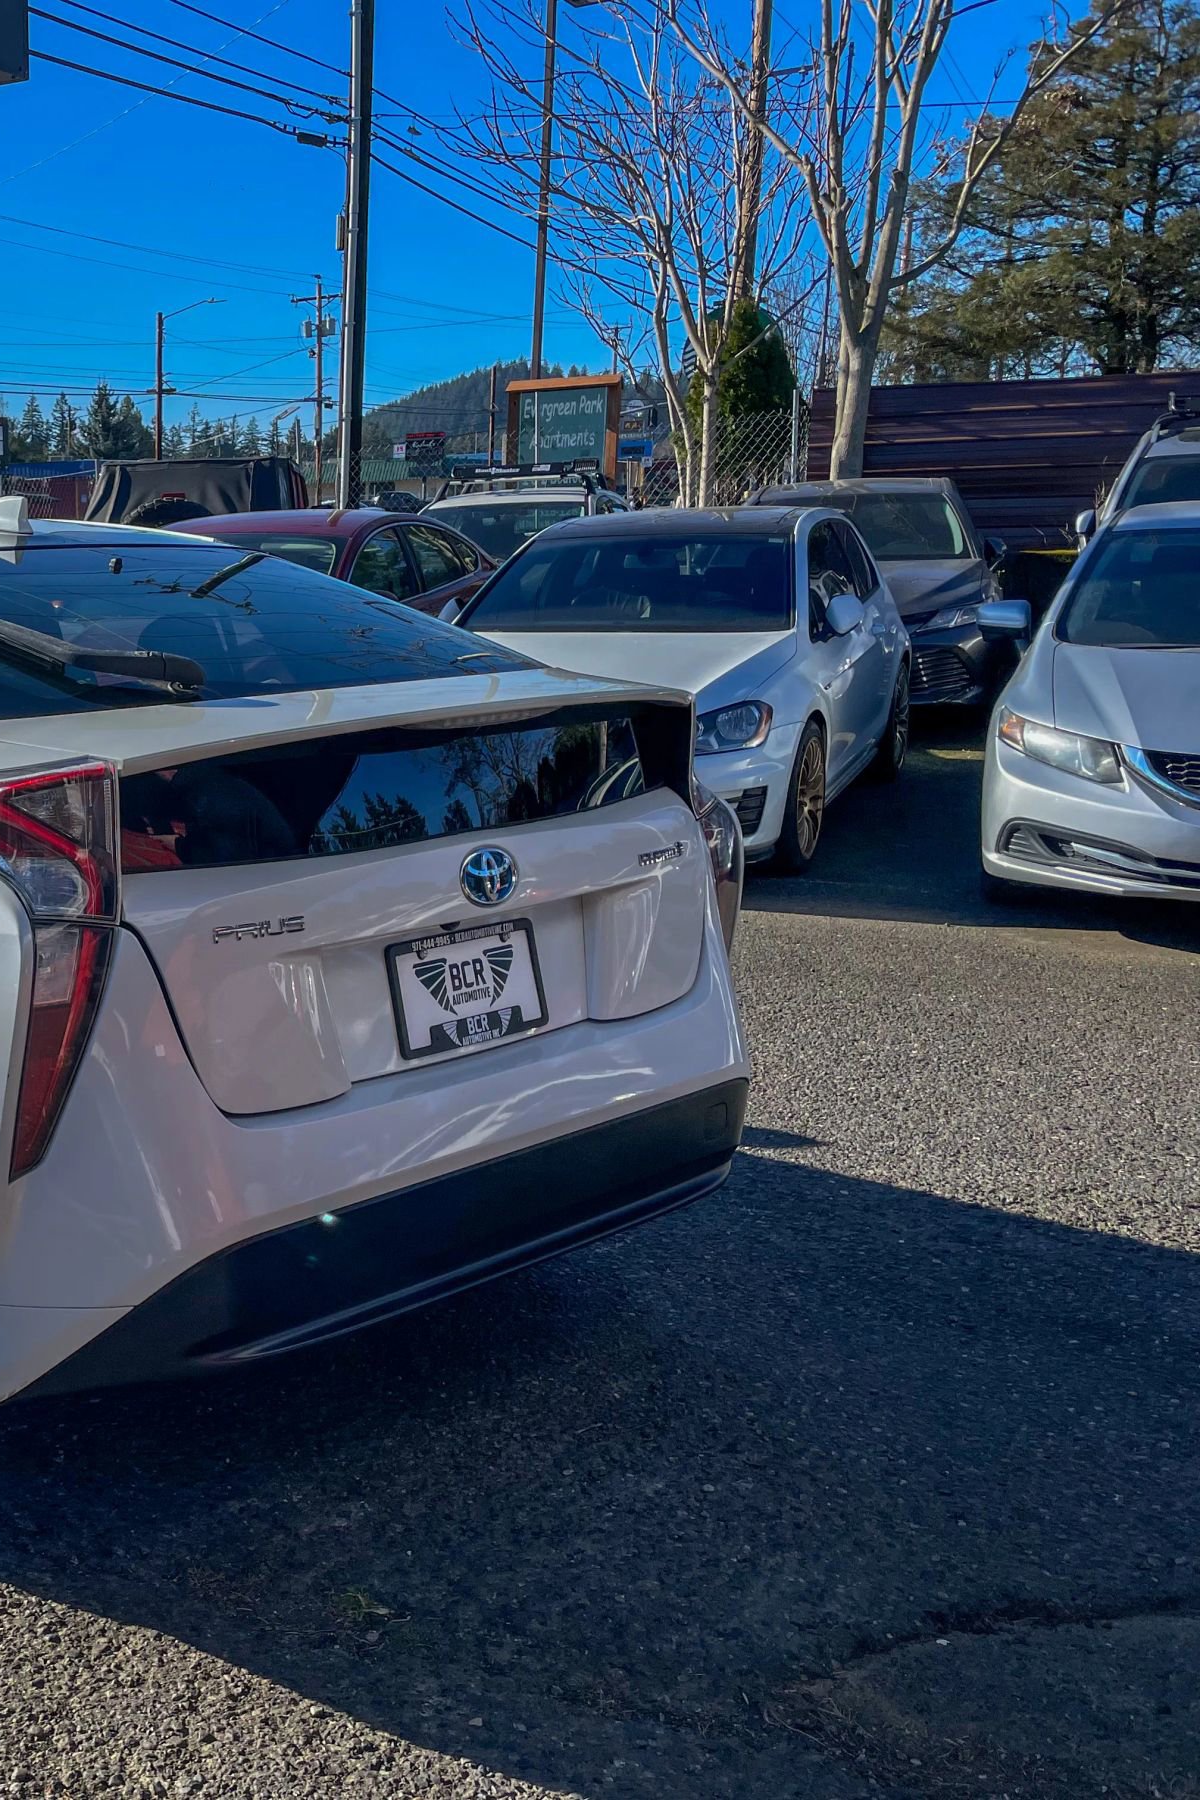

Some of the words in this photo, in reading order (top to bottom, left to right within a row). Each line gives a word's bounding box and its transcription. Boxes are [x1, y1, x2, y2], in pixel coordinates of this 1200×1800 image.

[579, 394, 604, 415] Park
[213, 916, 305, 944] PRIUS
[448, 958, 487, 992] BCR
[452, 986, 492, 1006] AUTOMOTIVE
[466, 1014, 490, 1035] BCR
[462, 1030, 492, 1047] AUTOMOTIVE
